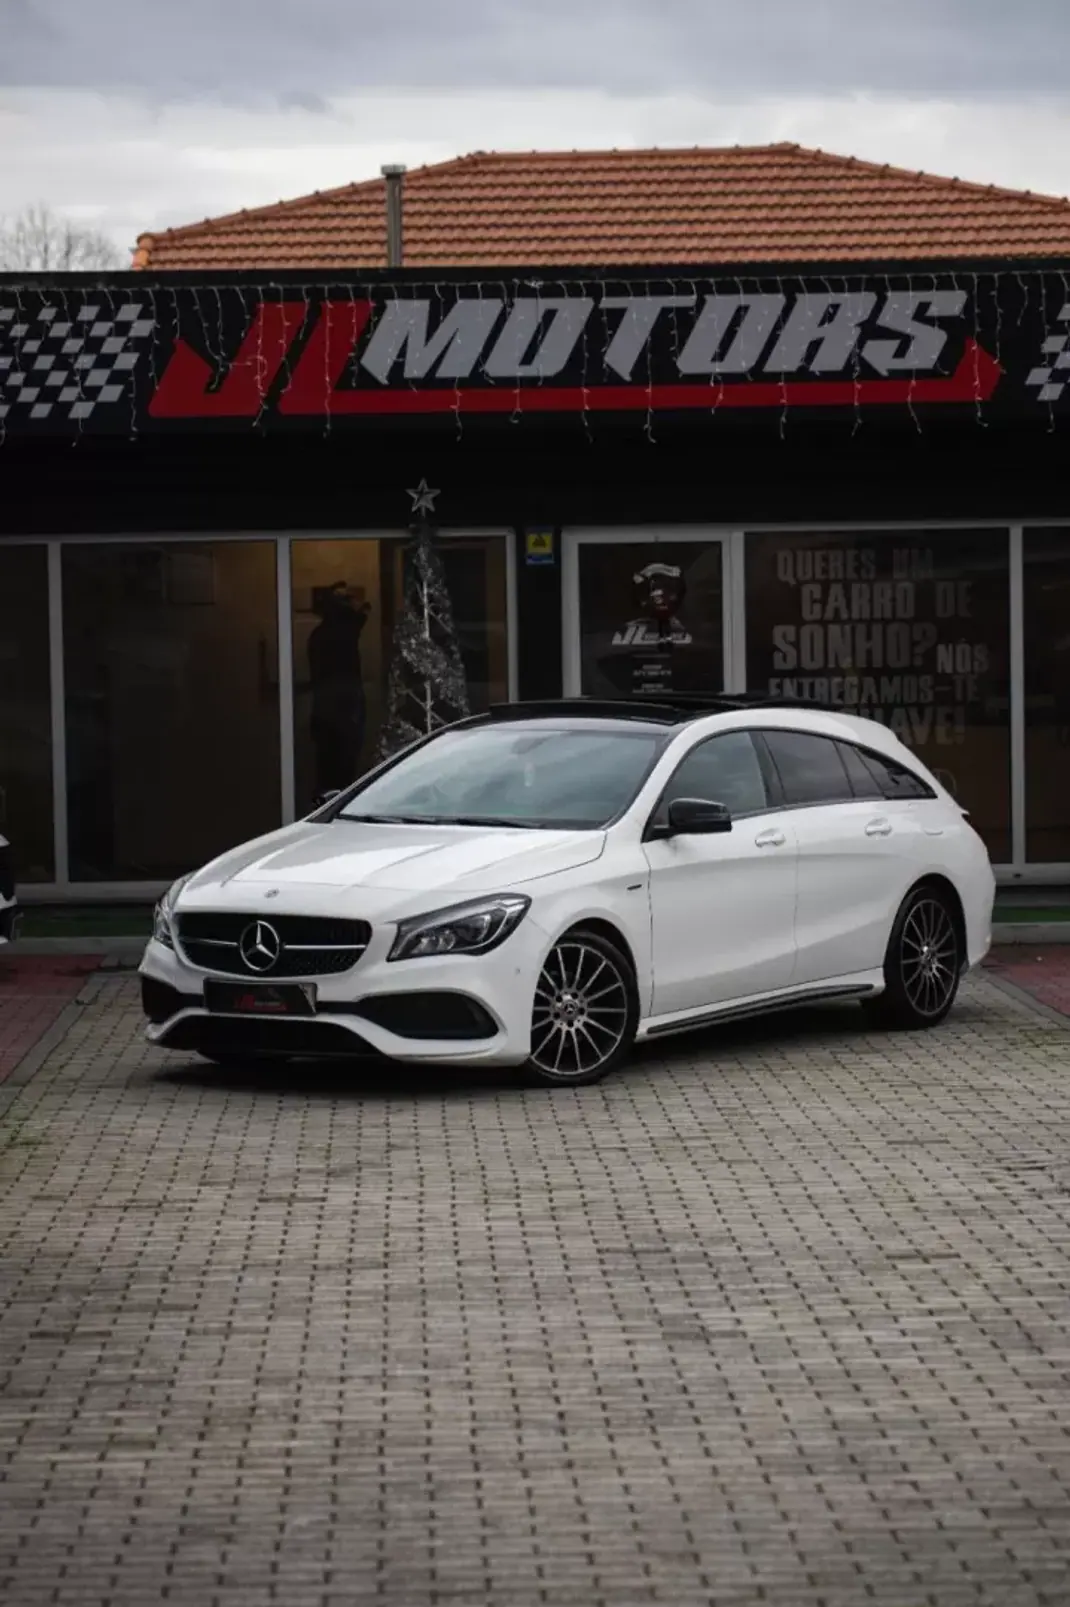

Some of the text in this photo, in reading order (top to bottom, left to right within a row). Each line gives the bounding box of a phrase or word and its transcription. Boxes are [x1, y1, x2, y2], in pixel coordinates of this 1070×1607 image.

[360, 289, 967, 385] MOTORS
[776, 549, 876, 585] QUERES
[801, 581, 973, 621] CARRO DE
[772, 622, 937, 670] SONHO?
[843, 706, 966, 745] AVE!
